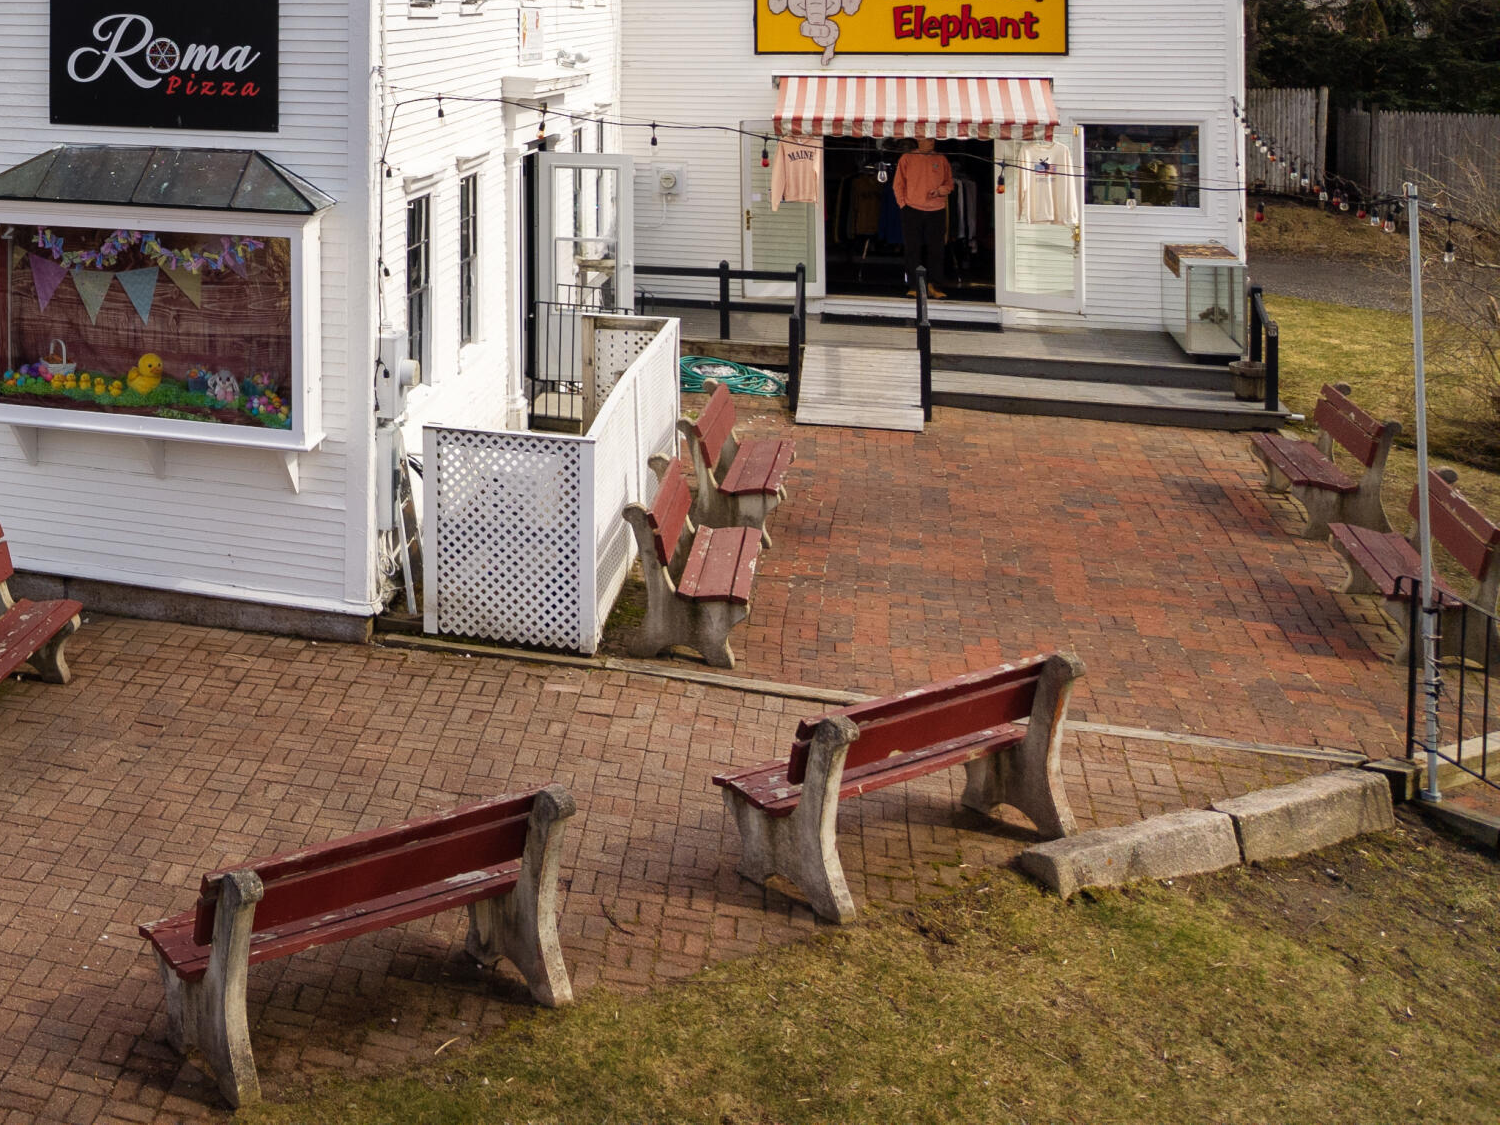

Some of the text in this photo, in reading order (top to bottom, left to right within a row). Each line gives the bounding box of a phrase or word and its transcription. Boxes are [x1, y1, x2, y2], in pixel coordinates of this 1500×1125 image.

[893, 4, 1039, 47] Elephant
[67, 13, 261, 89] Roma
[165, 73, 260, 97] Pizza
[787, 149, 814, 162] MAINE
